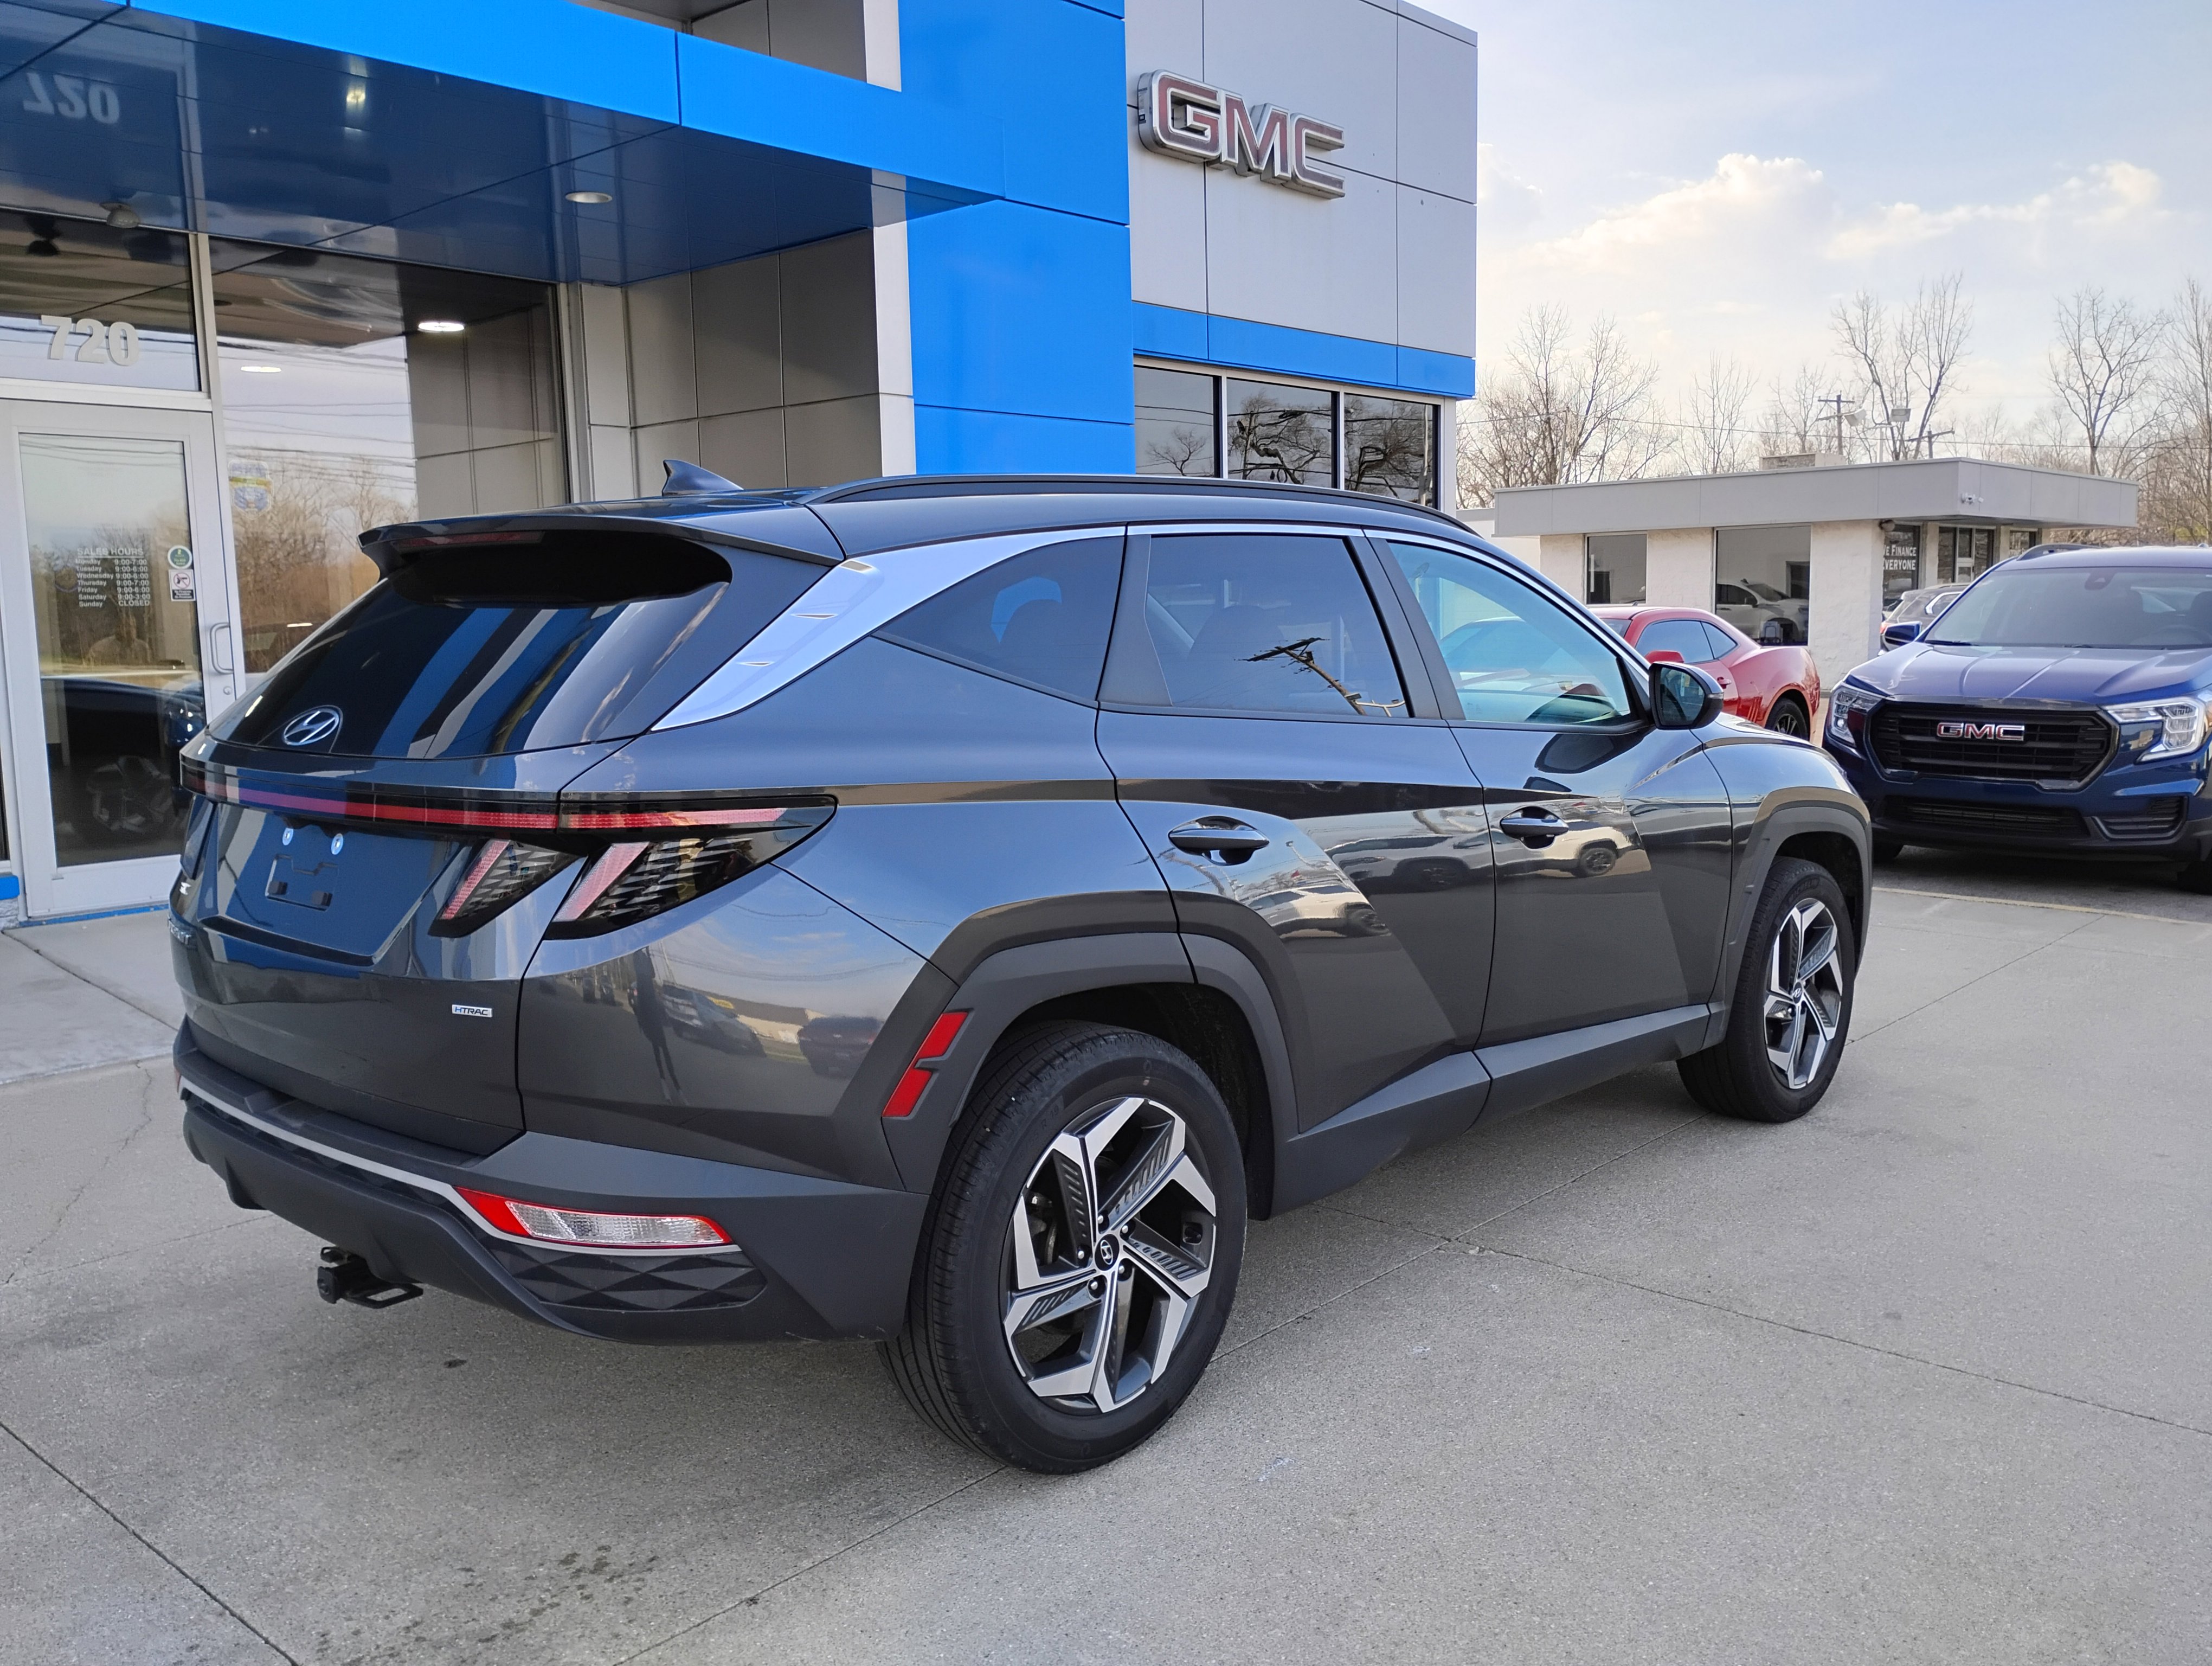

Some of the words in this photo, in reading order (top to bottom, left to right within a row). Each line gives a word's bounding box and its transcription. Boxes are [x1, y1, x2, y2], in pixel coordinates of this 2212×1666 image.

[1139, 69, 1346, 199] GMC
[40, 315, 139, 366] 720
[1891, 544, 1917, 556] FINANCE
[1883, 558, 1916, 570] VERYONE
[1937, 722, 2025, 741] GMC
[454, 1006, 488, 1016] HTRAC
